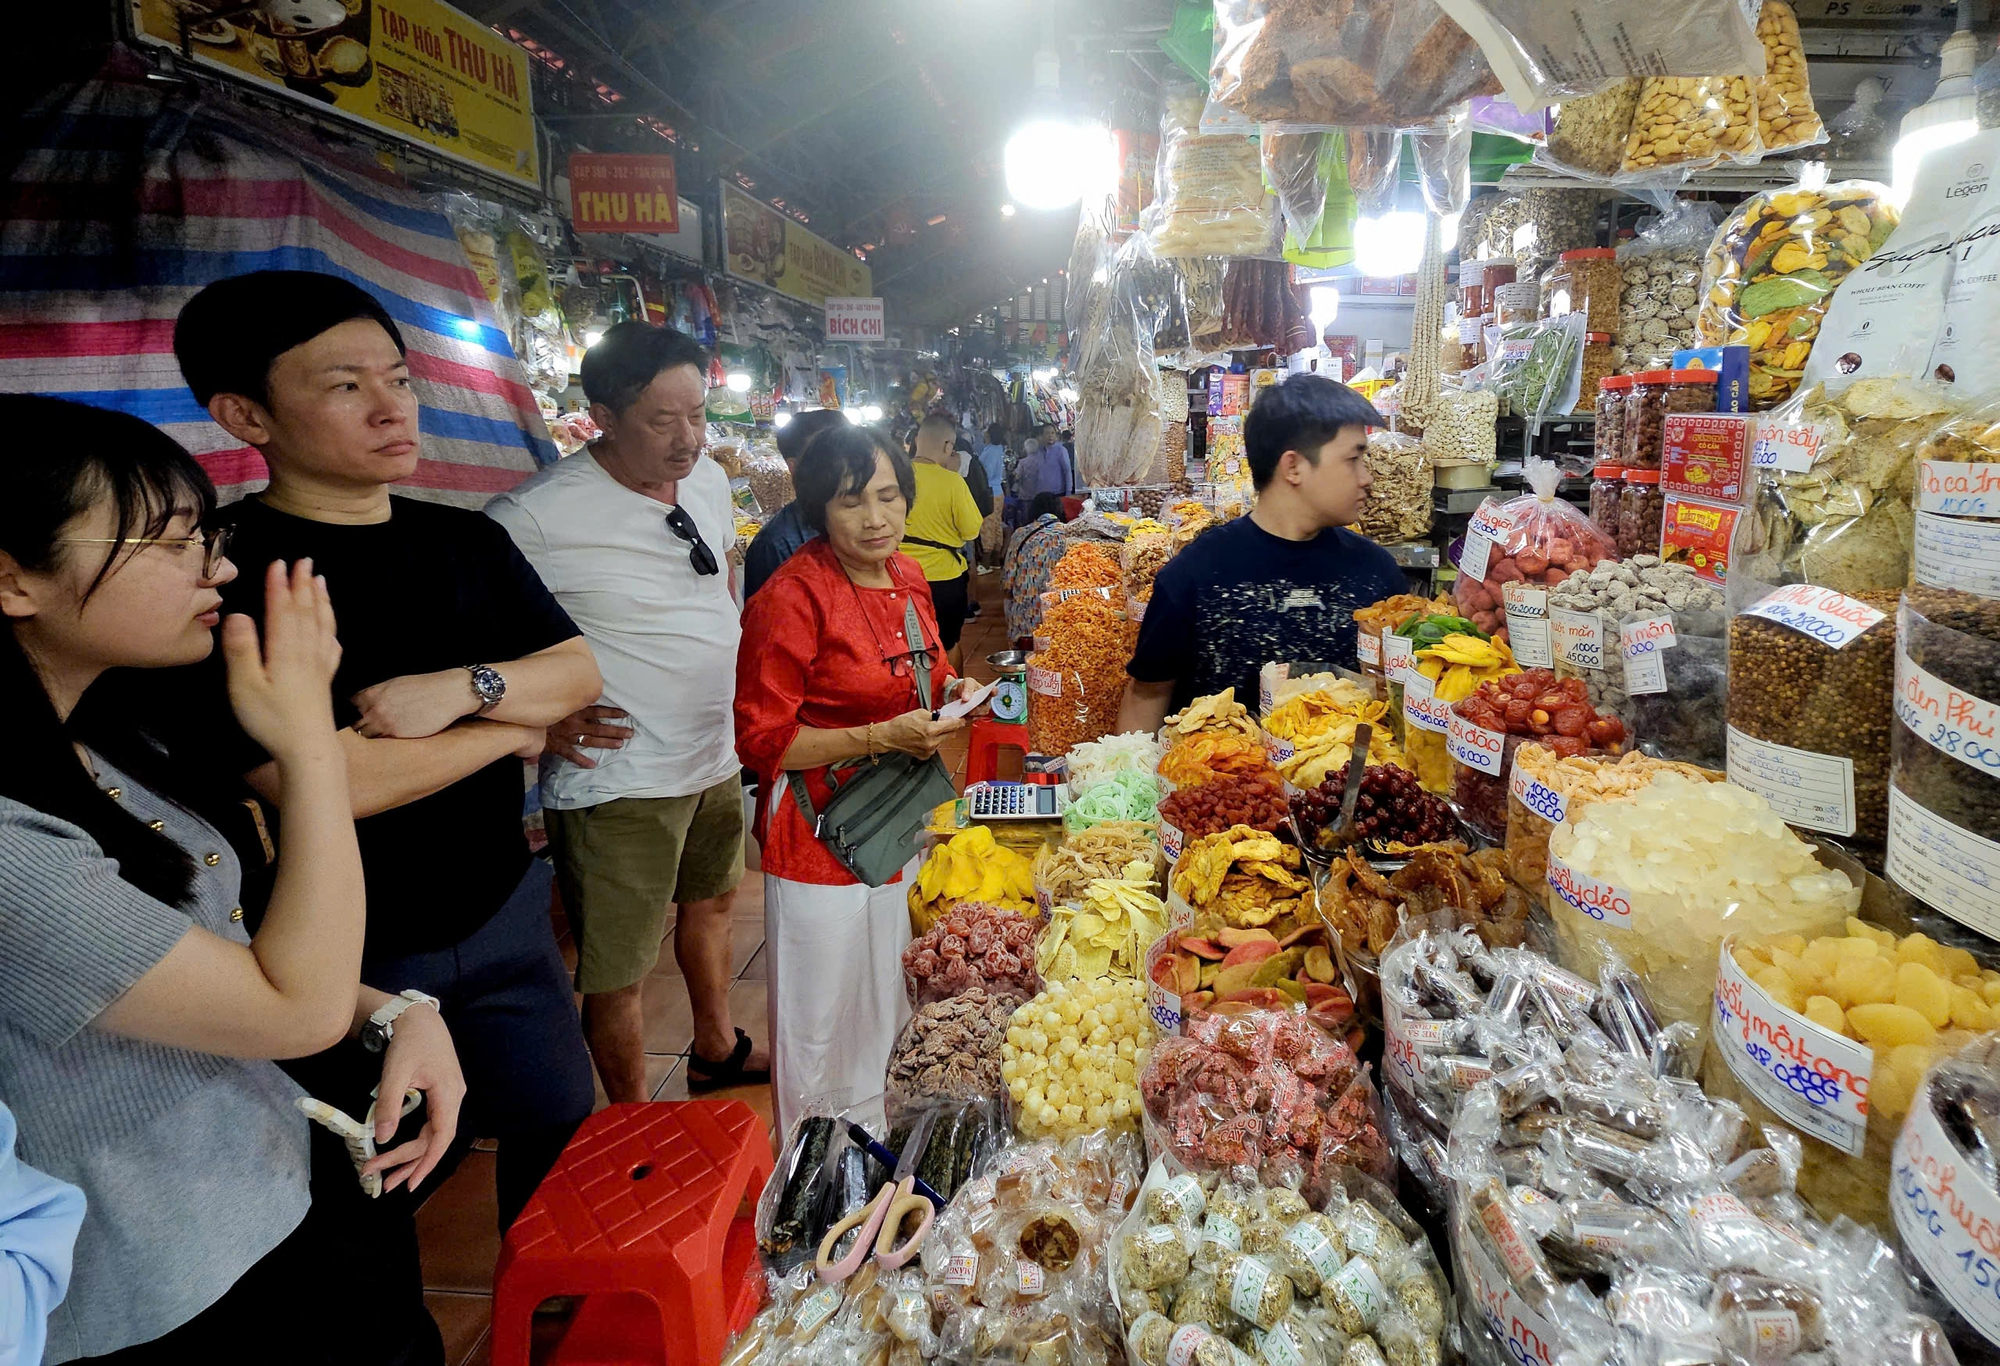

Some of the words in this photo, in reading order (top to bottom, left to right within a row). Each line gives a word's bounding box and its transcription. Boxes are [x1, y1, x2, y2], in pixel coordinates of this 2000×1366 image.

[1825, 1, 1850, 15] PS
[377, 4, 409, 43] TẠP
[412, 24, 444, 63] HÓA
[443, 26, 487, 84] THU
[491, 53, 519, 102] HÀ
[579, 191, 628, 222] THU
[634, 185, 672, 222] HÀ
[1850, 285, 1875, 296] WHOLE
[1900, 282, 1928, 291] COFFE
[1967, 274, 1998, 285] COFFEE
[829, 313, 858, 335] BÍCH
[861, 318, 881, 335] CHI
[1730, 400, 1739, 414] AO
[1788, 425, 1820, 456] sấy
[1972, 468, 2000, 494] tr
[1818, 594, 1874, 629] Quốc
[1781, 612, 1845, 643] 28000
[1566, 652, 1599, 665] 45000
[1572, 643, 1601, 653] 100G
[1583, 885, 1631, 916] dẻo
[1753, 1015, 1813, 1065] mật
[1219, 1129, 1245, 1143] CAY
